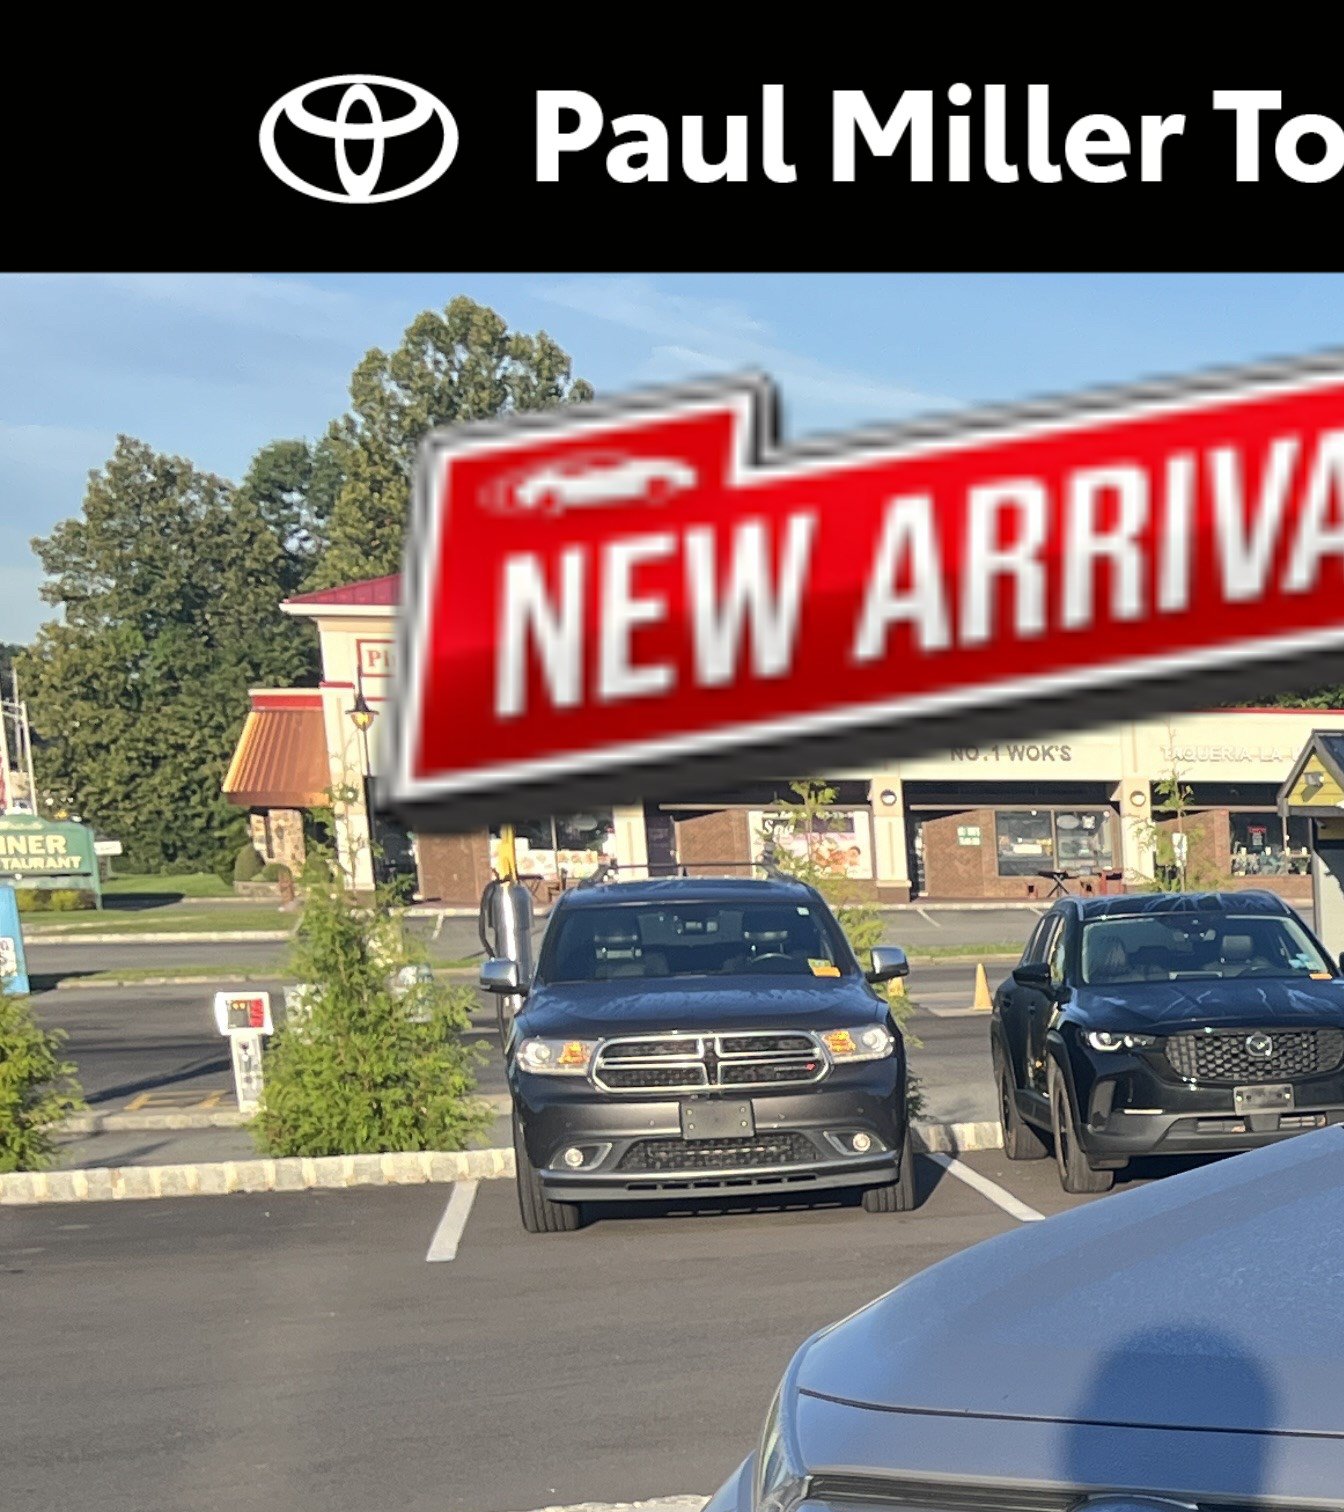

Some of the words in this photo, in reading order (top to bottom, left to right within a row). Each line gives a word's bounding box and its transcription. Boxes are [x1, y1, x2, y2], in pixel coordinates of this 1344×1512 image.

[1006, 745, 1072, 761] WOK'S
[1160, 747, 1253, 762] TAQUERIA
[1259, 747, 1283, 762] LA
[0, 856, 82, 869] TAURANT
